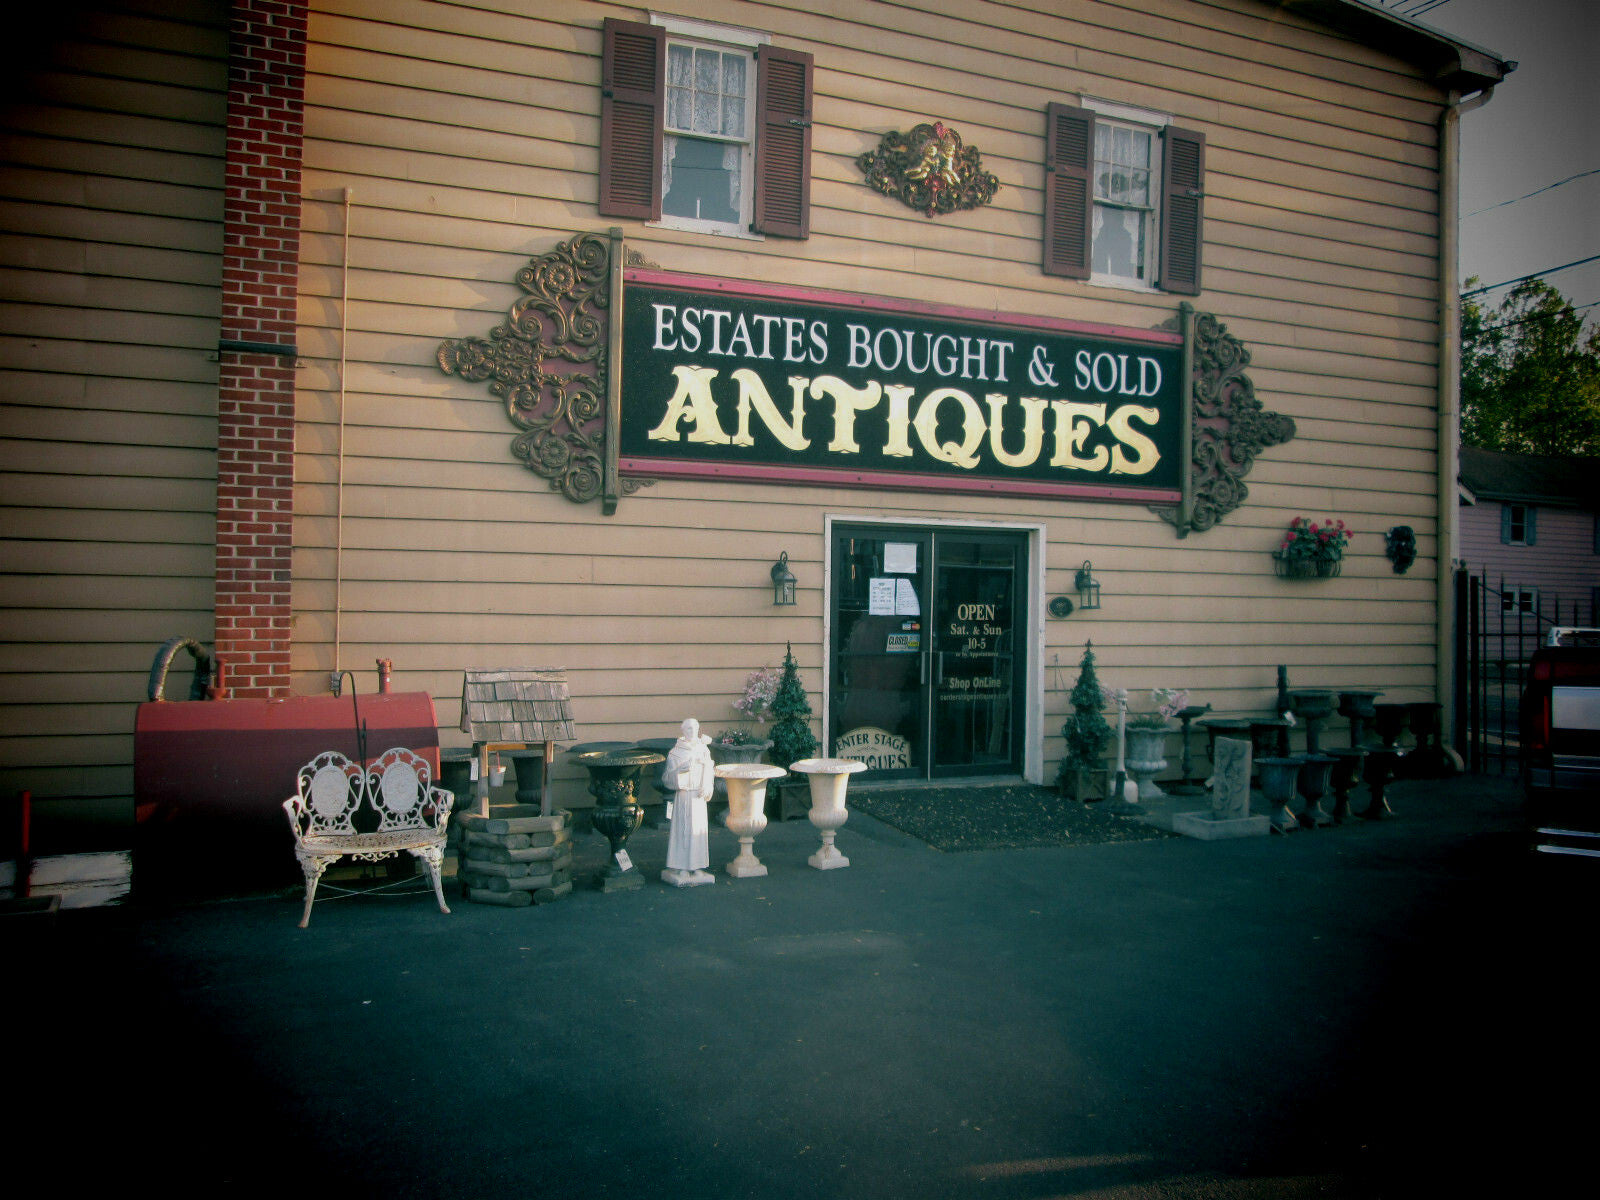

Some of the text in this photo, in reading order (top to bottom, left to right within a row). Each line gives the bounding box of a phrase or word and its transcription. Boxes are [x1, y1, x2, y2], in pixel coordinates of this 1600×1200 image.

[652, 303, 1162, 397] ESTATES BOUGHT & SOLD
[647, 364, 1162, 475] ANTIQUES
[957, 603, 996, 621] OPEN
[950, 623, 1002, 635] Sat. & Sun
[967, 637, 987, 650] 10-5
[949, 676, 1002, 691] Shop OnLine
[874, 733, 906, 753] STAGE
